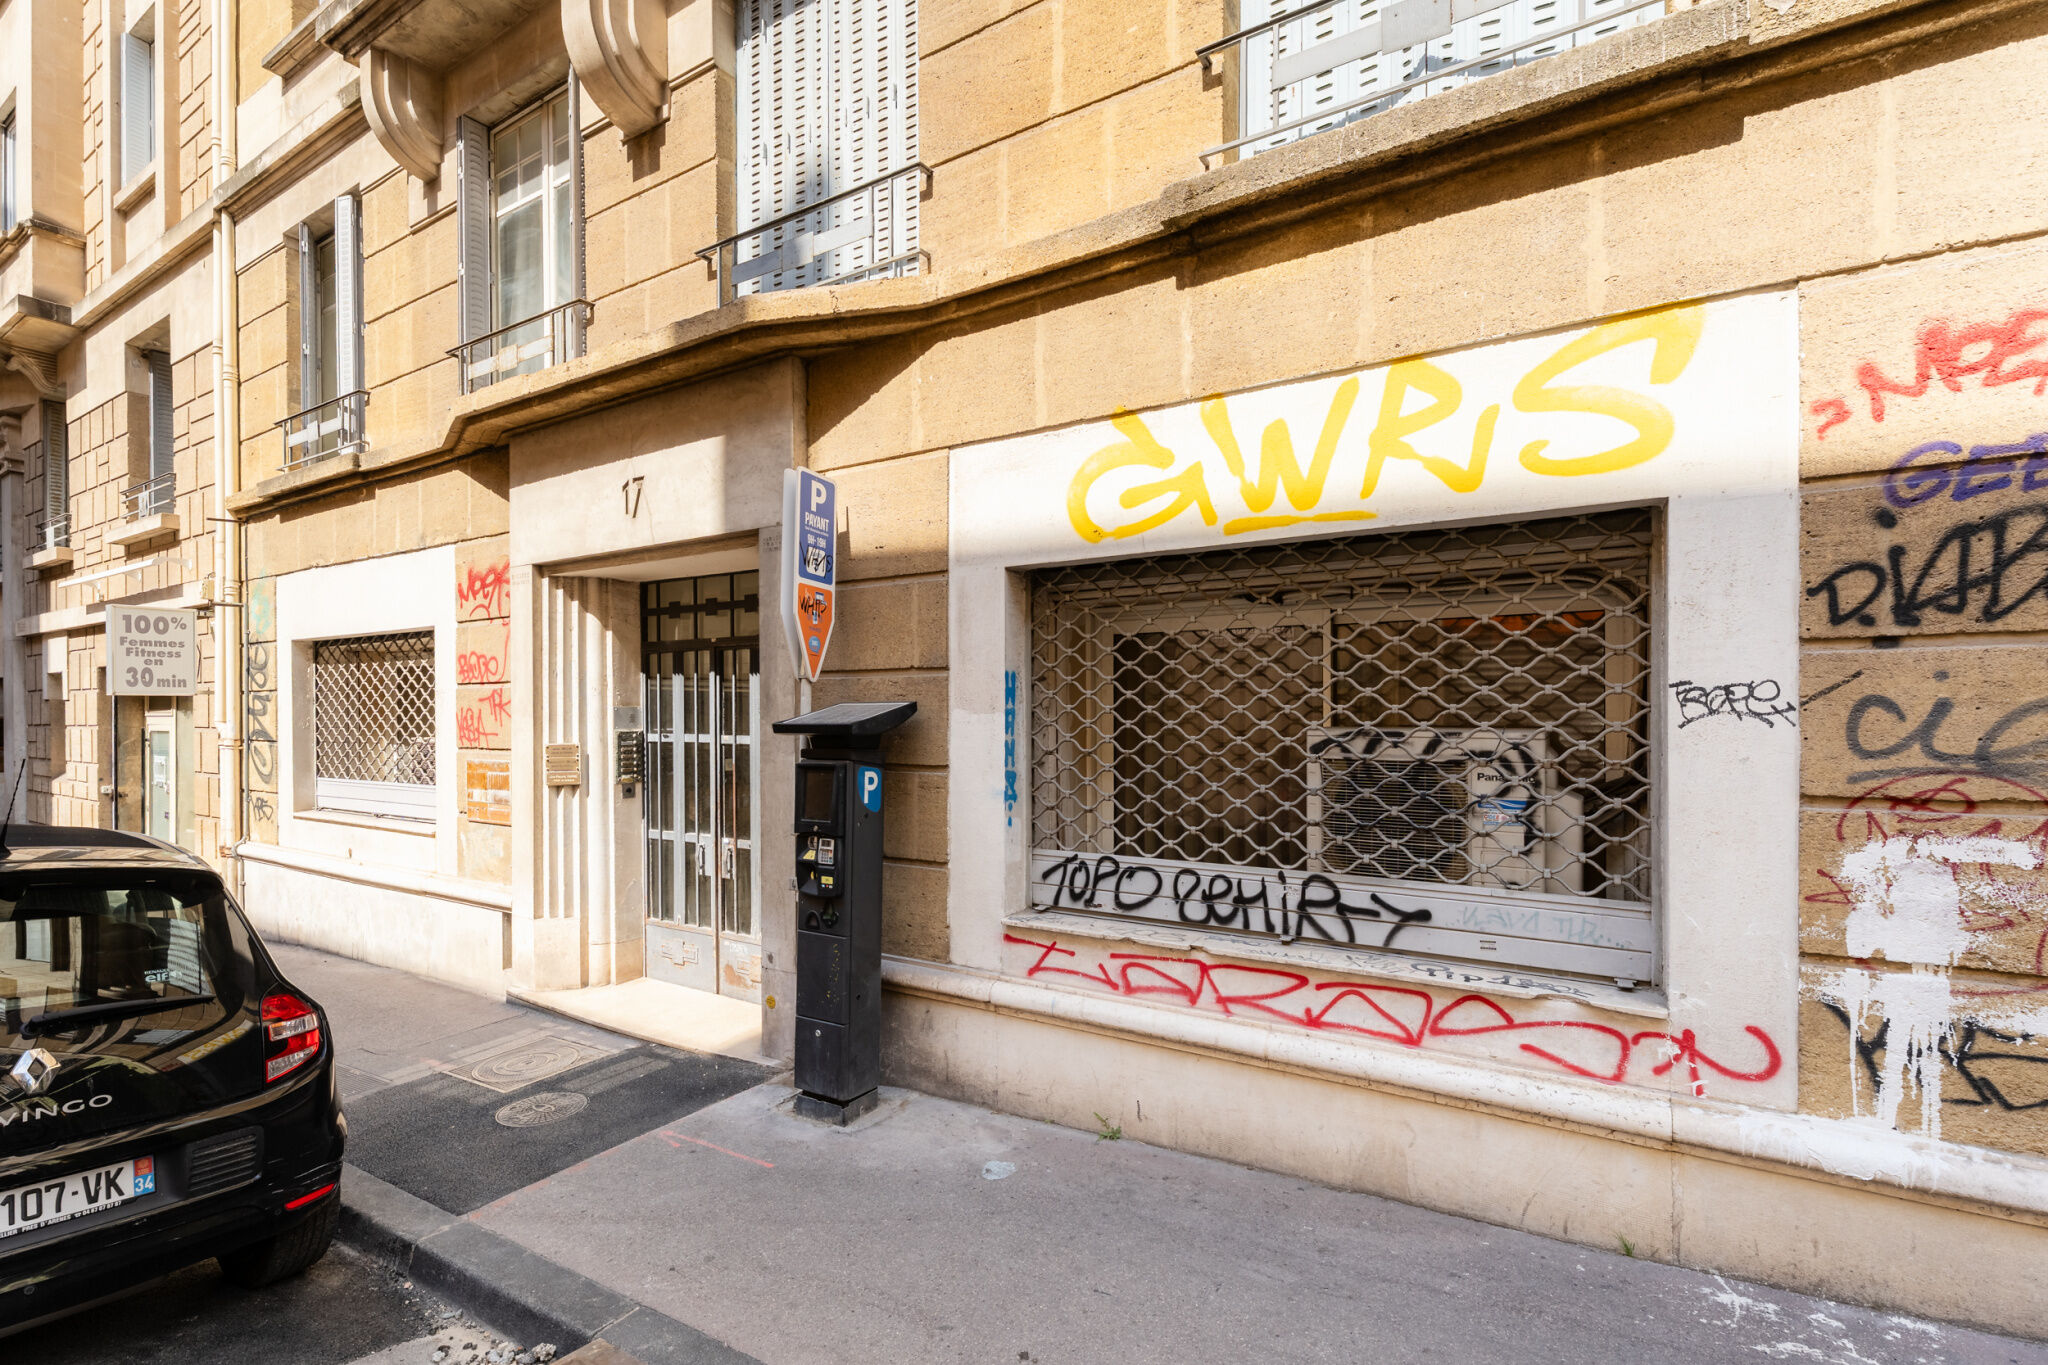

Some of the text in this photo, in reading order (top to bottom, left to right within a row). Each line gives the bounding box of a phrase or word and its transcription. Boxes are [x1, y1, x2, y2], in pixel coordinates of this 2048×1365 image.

[622, 475, 645, 519] 17
[810, 480, 827, 512] P
[804, 511, 829, 532] PAYANT
[122, 614, 187, 635] 100%
[119, 636, 185, 648] Femmes
[125, 646, 182, 658] Fitness
[143, 658, 164, 666] en
[126, 666, 187, 688] 30 min
[864, 771, 878, 804] P
[135, 1175, 153, 1192] 34
